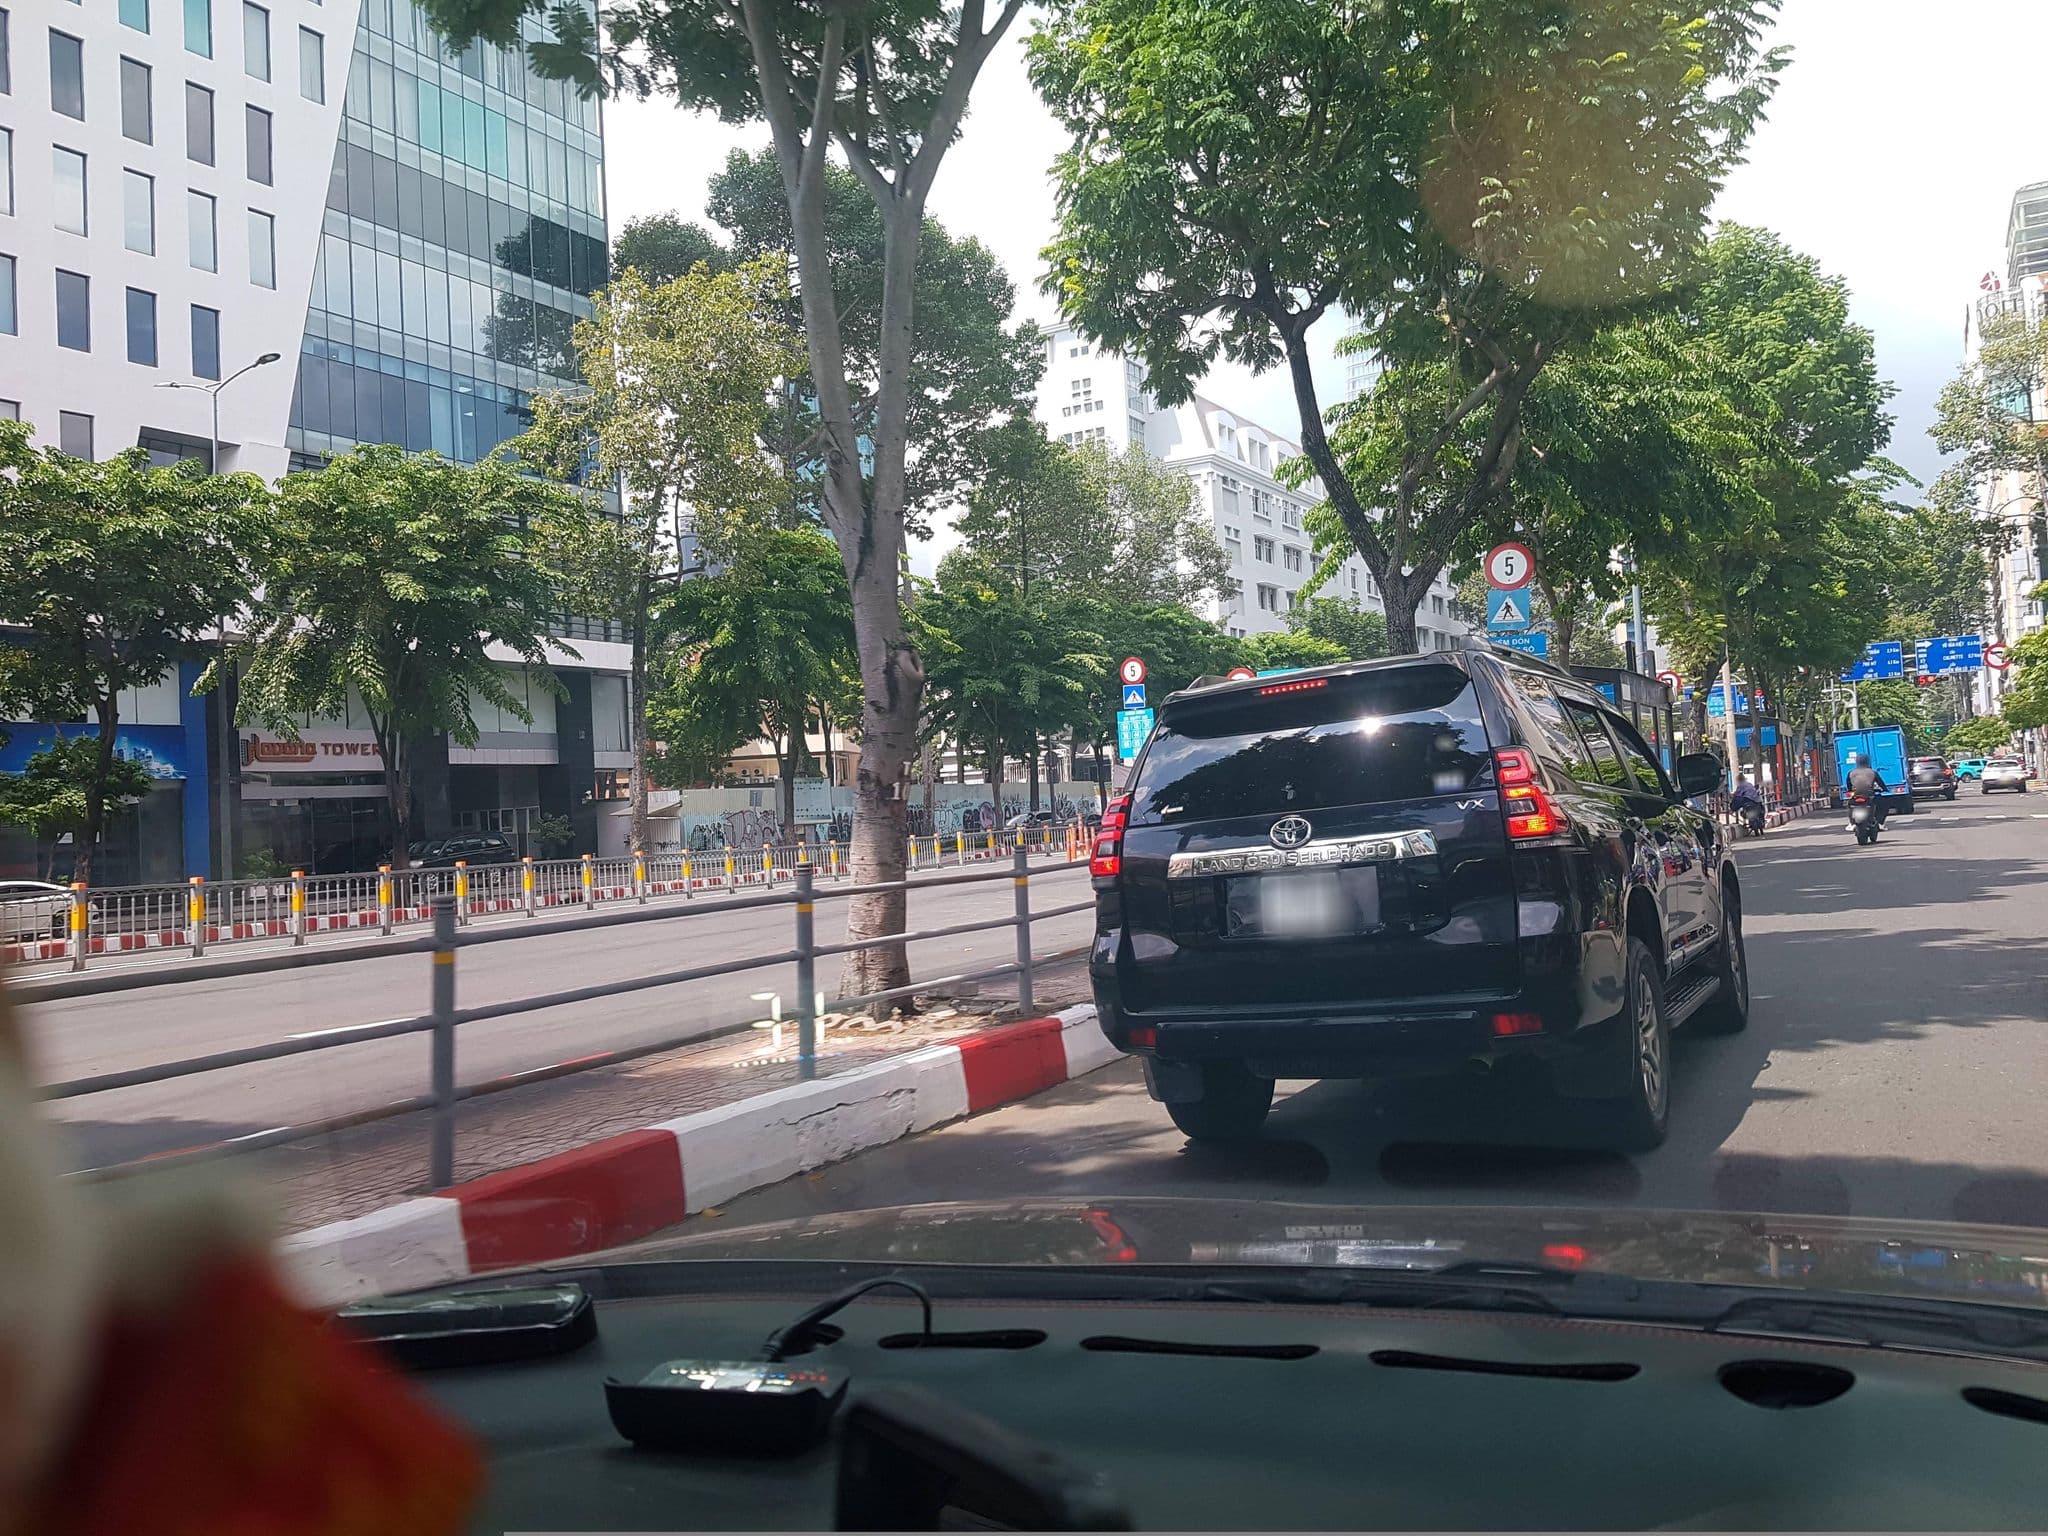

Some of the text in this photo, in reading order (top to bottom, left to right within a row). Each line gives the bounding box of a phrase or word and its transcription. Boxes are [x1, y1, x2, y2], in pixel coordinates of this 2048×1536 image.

[1504, 557, 1514, 576] 5
[1130, 665, 1136, 677] 5
[321, 742, 380, 756] TOWER
[1455, 798, 1486, 810] VX
[1199, 842, 1391, 873] LAND CRUISER PRADO
